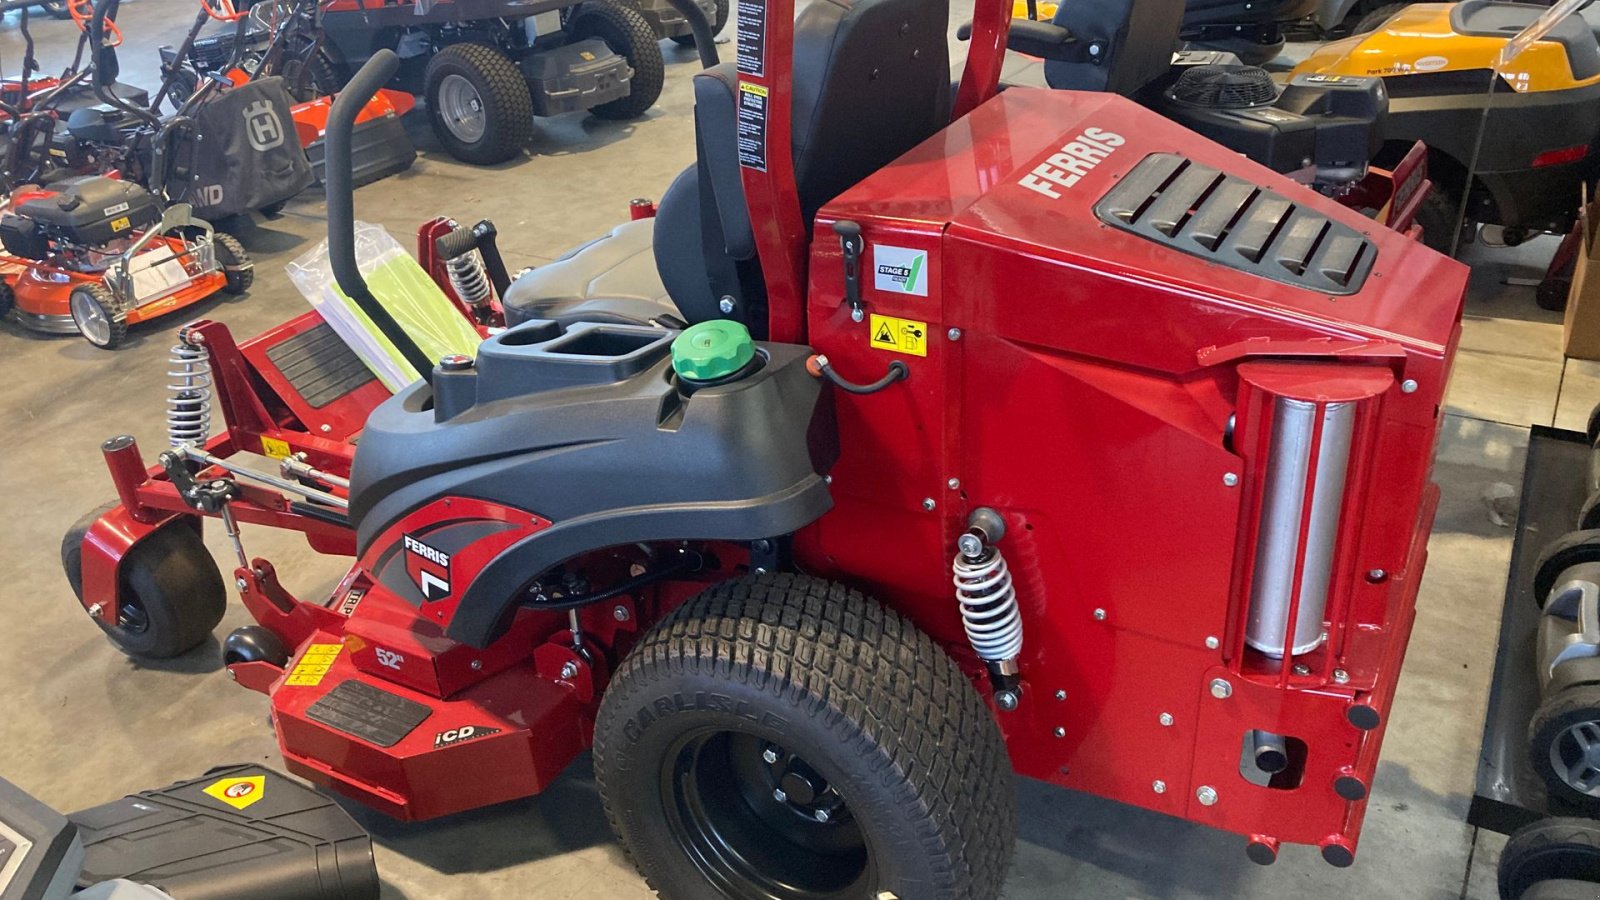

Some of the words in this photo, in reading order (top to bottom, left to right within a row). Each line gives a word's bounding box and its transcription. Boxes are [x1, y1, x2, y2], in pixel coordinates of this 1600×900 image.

[746, 85, 766, 94] CAUTION
[1017, 127, 1125, 199] FERRIS
[880, 266, 902, 276] STAGE
[404, 535, 449, 567] FERRIS
[375, 647, 404, 670] 52"
[623, 691, 789, 744] CARLISLE
[435, 726, 474, 744] iCD
